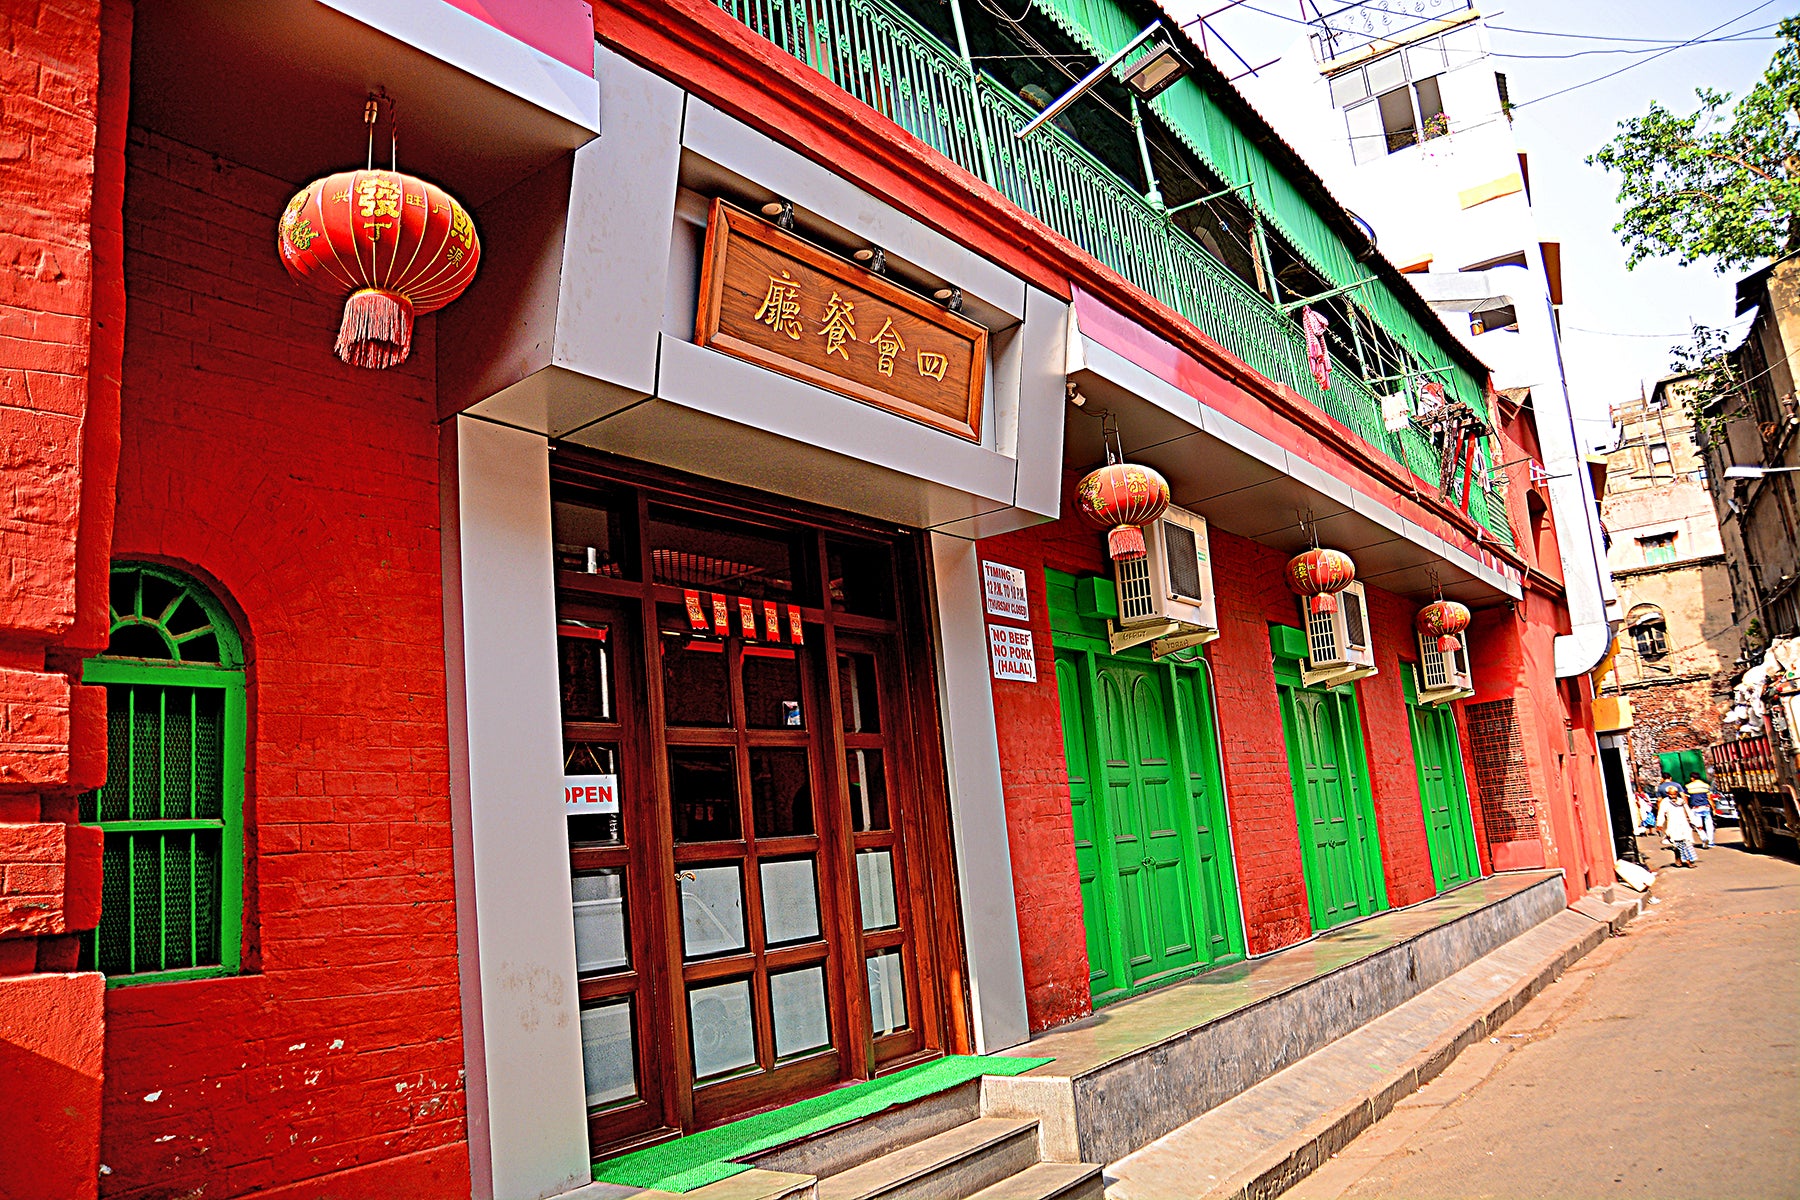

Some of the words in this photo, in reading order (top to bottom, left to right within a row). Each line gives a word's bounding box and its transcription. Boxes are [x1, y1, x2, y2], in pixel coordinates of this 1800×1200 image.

[1003, 583, 1010, 599] TO
[993, 629, 1006, 643] NO
[1009, 631, 1029, 646] BEEF
[993, 644, 1007, 658] NO
[1009, 646, 1032, 661] PORK
[998, 660, 1032, 678] (HALAL)
